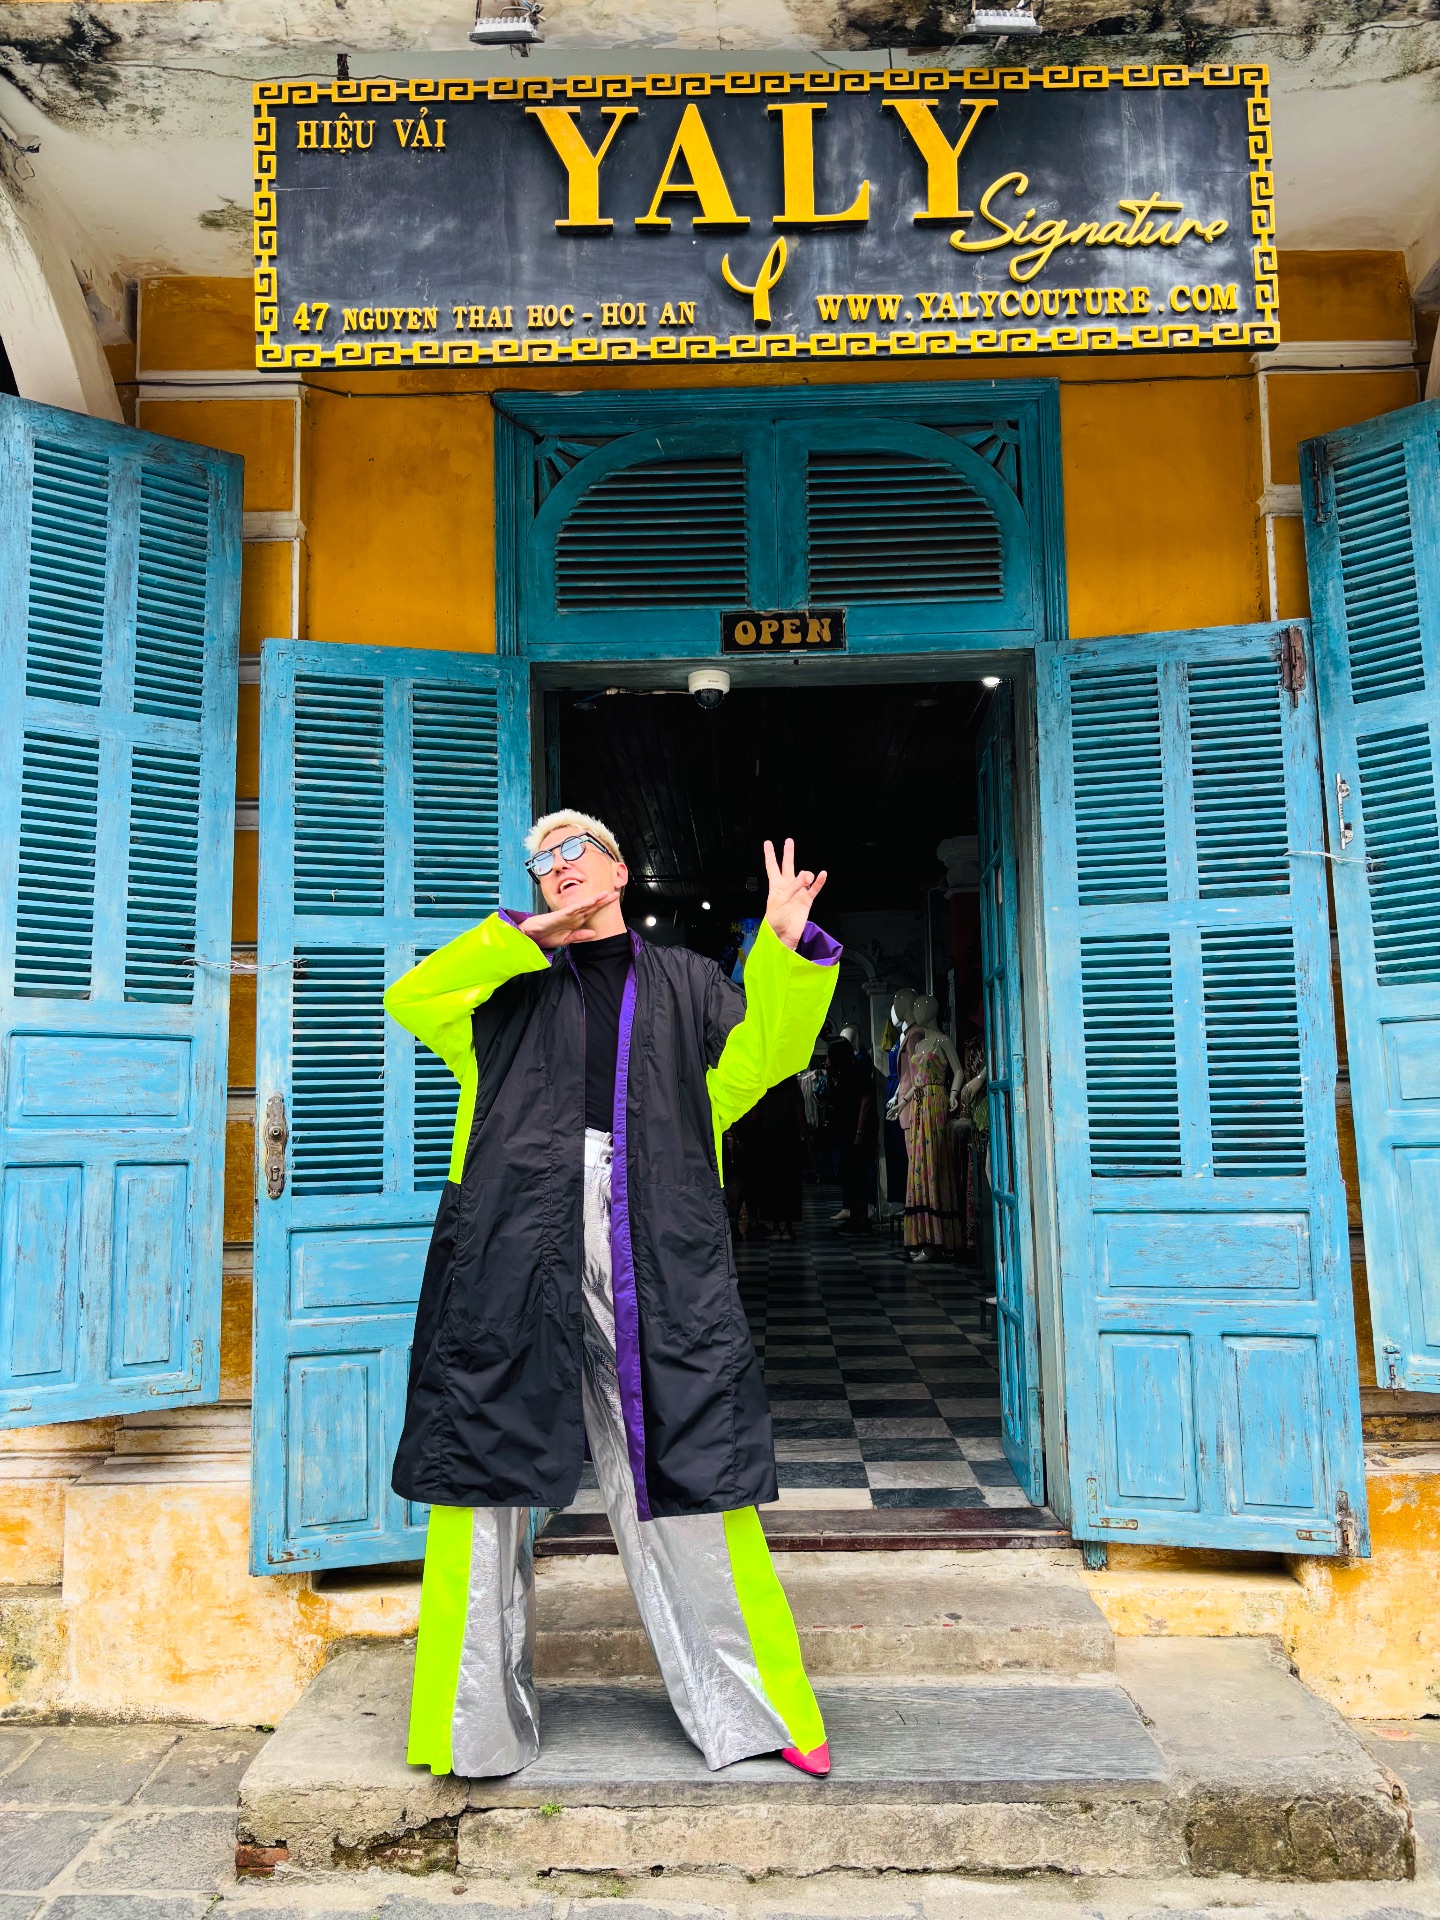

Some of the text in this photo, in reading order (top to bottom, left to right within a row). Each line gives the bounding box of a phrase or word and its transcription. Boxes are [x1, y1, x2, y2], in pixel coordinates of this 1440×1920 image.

[297, 106, 446, 154] HIỆU VẢI
[525, 98, 999, 228] YALY
[949, 171, 1229, 282] Signature
[292, 302, 328, 332] 47
[342, 307, 438, 332] NGUYEN
[453, 306, 512, 330] THAI
[527, 304, 575, 328] HOC
[601, 303, 646, 327] HOI
[658, 301, 695, 326] AN
[816, 284, 1239, 322] WWW.YALYCOUTURE.COM
[734, 617, 832, 646] OPEN
